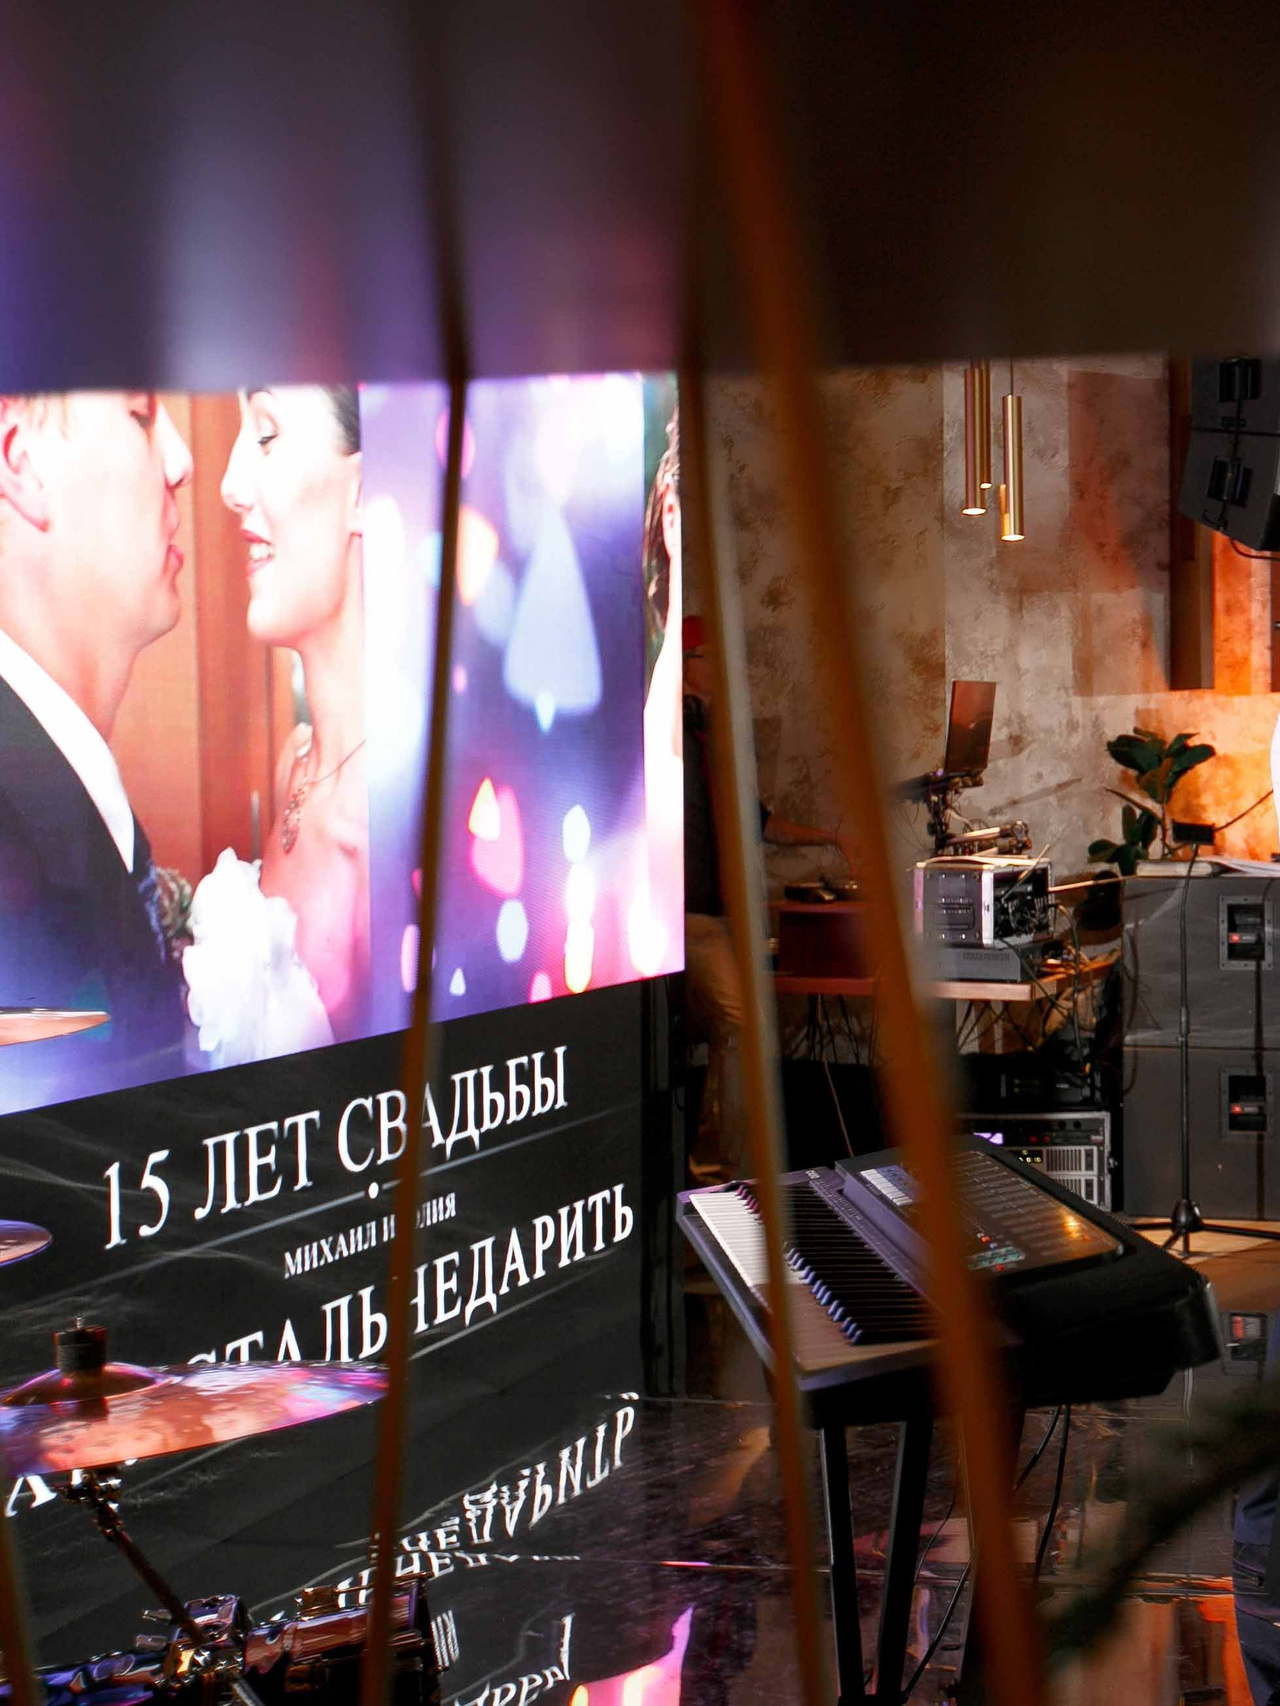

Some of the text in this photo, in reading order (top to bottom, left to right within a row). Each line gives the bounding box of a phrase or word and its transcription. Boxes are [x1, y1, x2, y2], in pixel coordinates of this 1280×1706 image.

[103, 1045, 568, 1251] 15 ЛЕТ СВАДЬБЫ
[284, 1192, 457, 1280] МИХАИЛ И ЛИЯ
